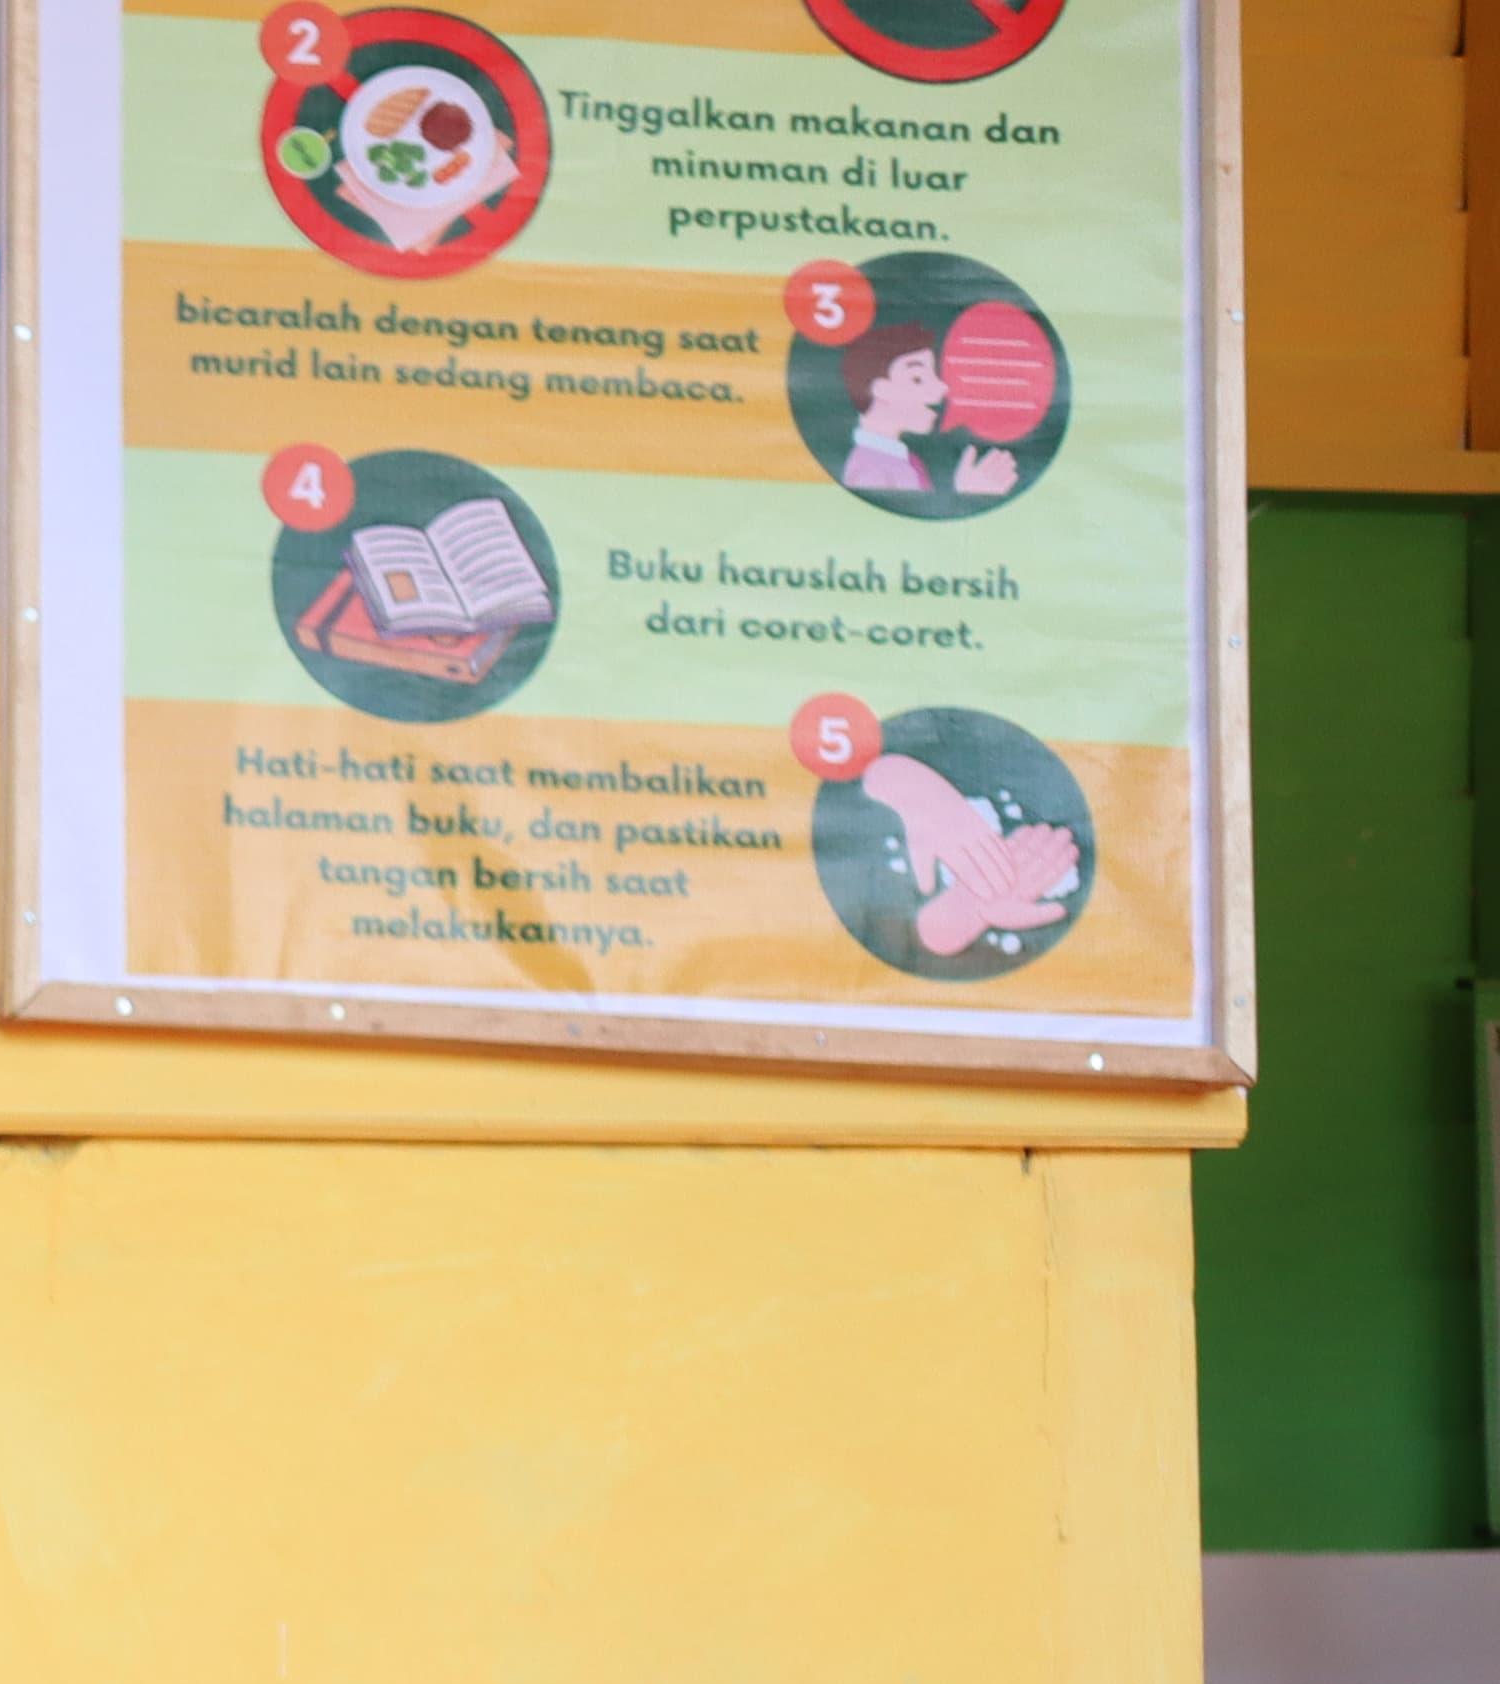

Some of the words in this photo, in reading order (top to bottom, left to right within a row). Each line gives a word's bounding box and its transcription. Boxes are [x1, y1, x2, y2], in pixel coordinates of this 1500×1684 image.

[289, 20, 320, 64] 2
[559, 90, 775, 136] Tinggalkan
[791, 105, 970, 142] makanan
[985, 113, 1060, 144] dan
[652, 150, 828, 184] minuman
[842, 156, 876, 187] di
[892, 158, 968, 191] luar
[669, 204, 948, 240] perpustakaan.
[177, 292, 362, 332] bicaralah
[374, 304, 519, 348] dengan
[532, 318, 665, 359] tenang
[679, 330, 759, 353] saat
[812, 284, 844, 328] 3
[190, 347, 298, 378] murid
[311, 348, 381, 383] lain
[395, 356, 532, 402] sedang
[545, 367, 743, 403] membaca.
[290, 464, 325, 508] 4
[609, 549, 703, 583] Buku
[718, 552, 887, 593] haruslah
[901, 562, 1019, 600] bersih
[645, 601, 725, 636] dari
[739, 616, 982, 649] coret-coret.
[819, 717, 851, 763] 5
[237, 747, 416, 782] Hati-hati
[430, 760, 514, 785] saat
[527, 761, 766, 798] membalikan
[223, 792, 394, 833] halaman
[407, 802, 511, 842] buku,
[528, 807, 602, 842] dan
[615, 816, 782, 853] pastikan
[318, 856, 459, 897] tangan
[472, 856, 590, 891] bersih
[605, 870, 689, 896] saat
[353, 907, 655, 955] melakukannya.
